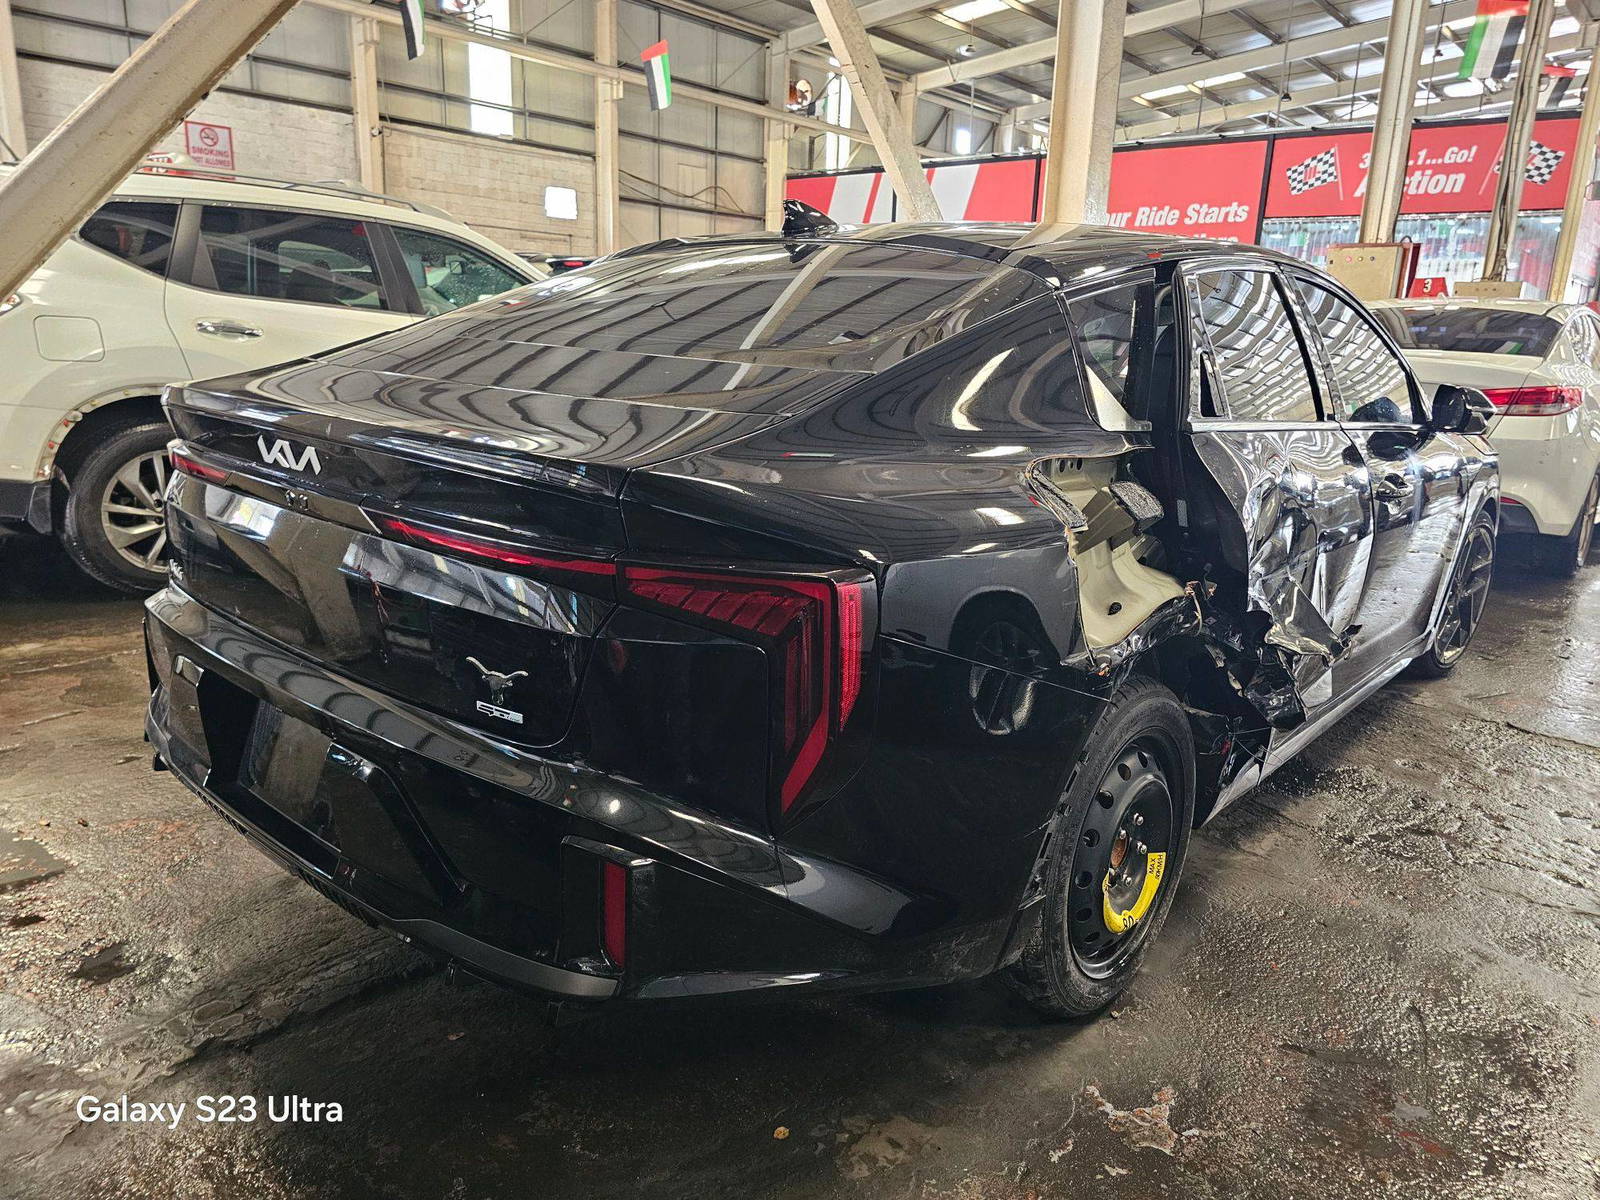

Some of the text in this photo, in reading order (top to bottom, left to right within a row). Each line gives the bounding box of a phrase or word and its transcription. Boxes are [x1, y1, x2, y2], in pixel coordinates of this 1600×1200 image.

[191, 145, 230, 158] SMOKING
[1353, 171, 1466, 198] Ation
[1134, 205, 1180, 227] Ride
[1184, 202, 1249, 225] Starts
[1422, 279, 1433, 293] 3
